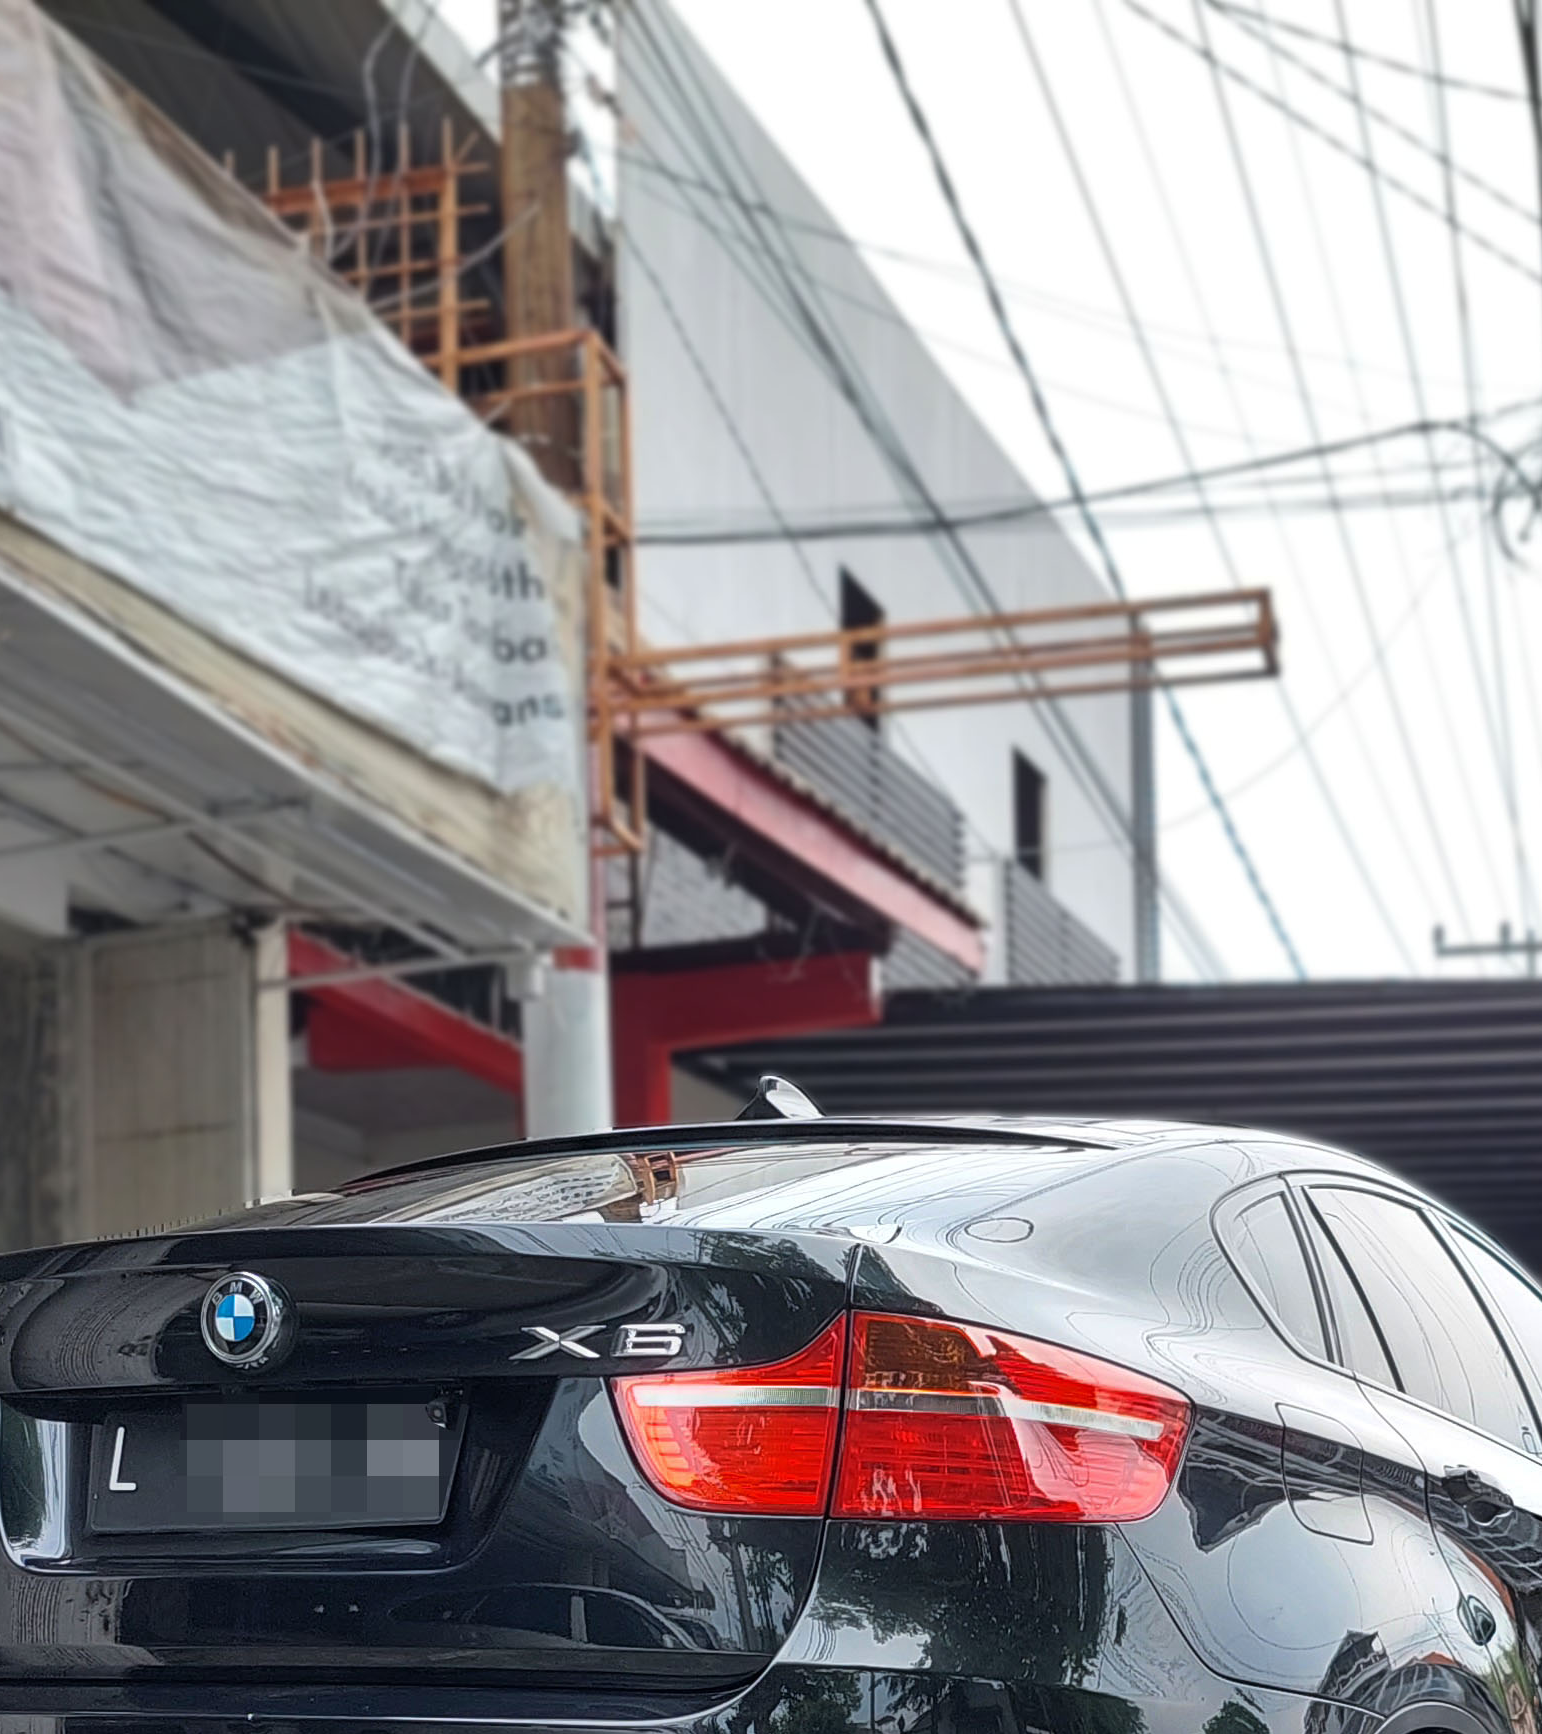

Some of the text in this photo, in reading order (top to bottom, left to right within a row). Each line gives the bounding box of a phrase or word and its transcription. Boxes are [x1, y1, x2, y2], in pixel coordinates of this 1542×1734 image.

[211, 1281, 265, 1306] BMW
[509, 1323, 687, 1361] X6
[109, 1426, 137, 1491] L
